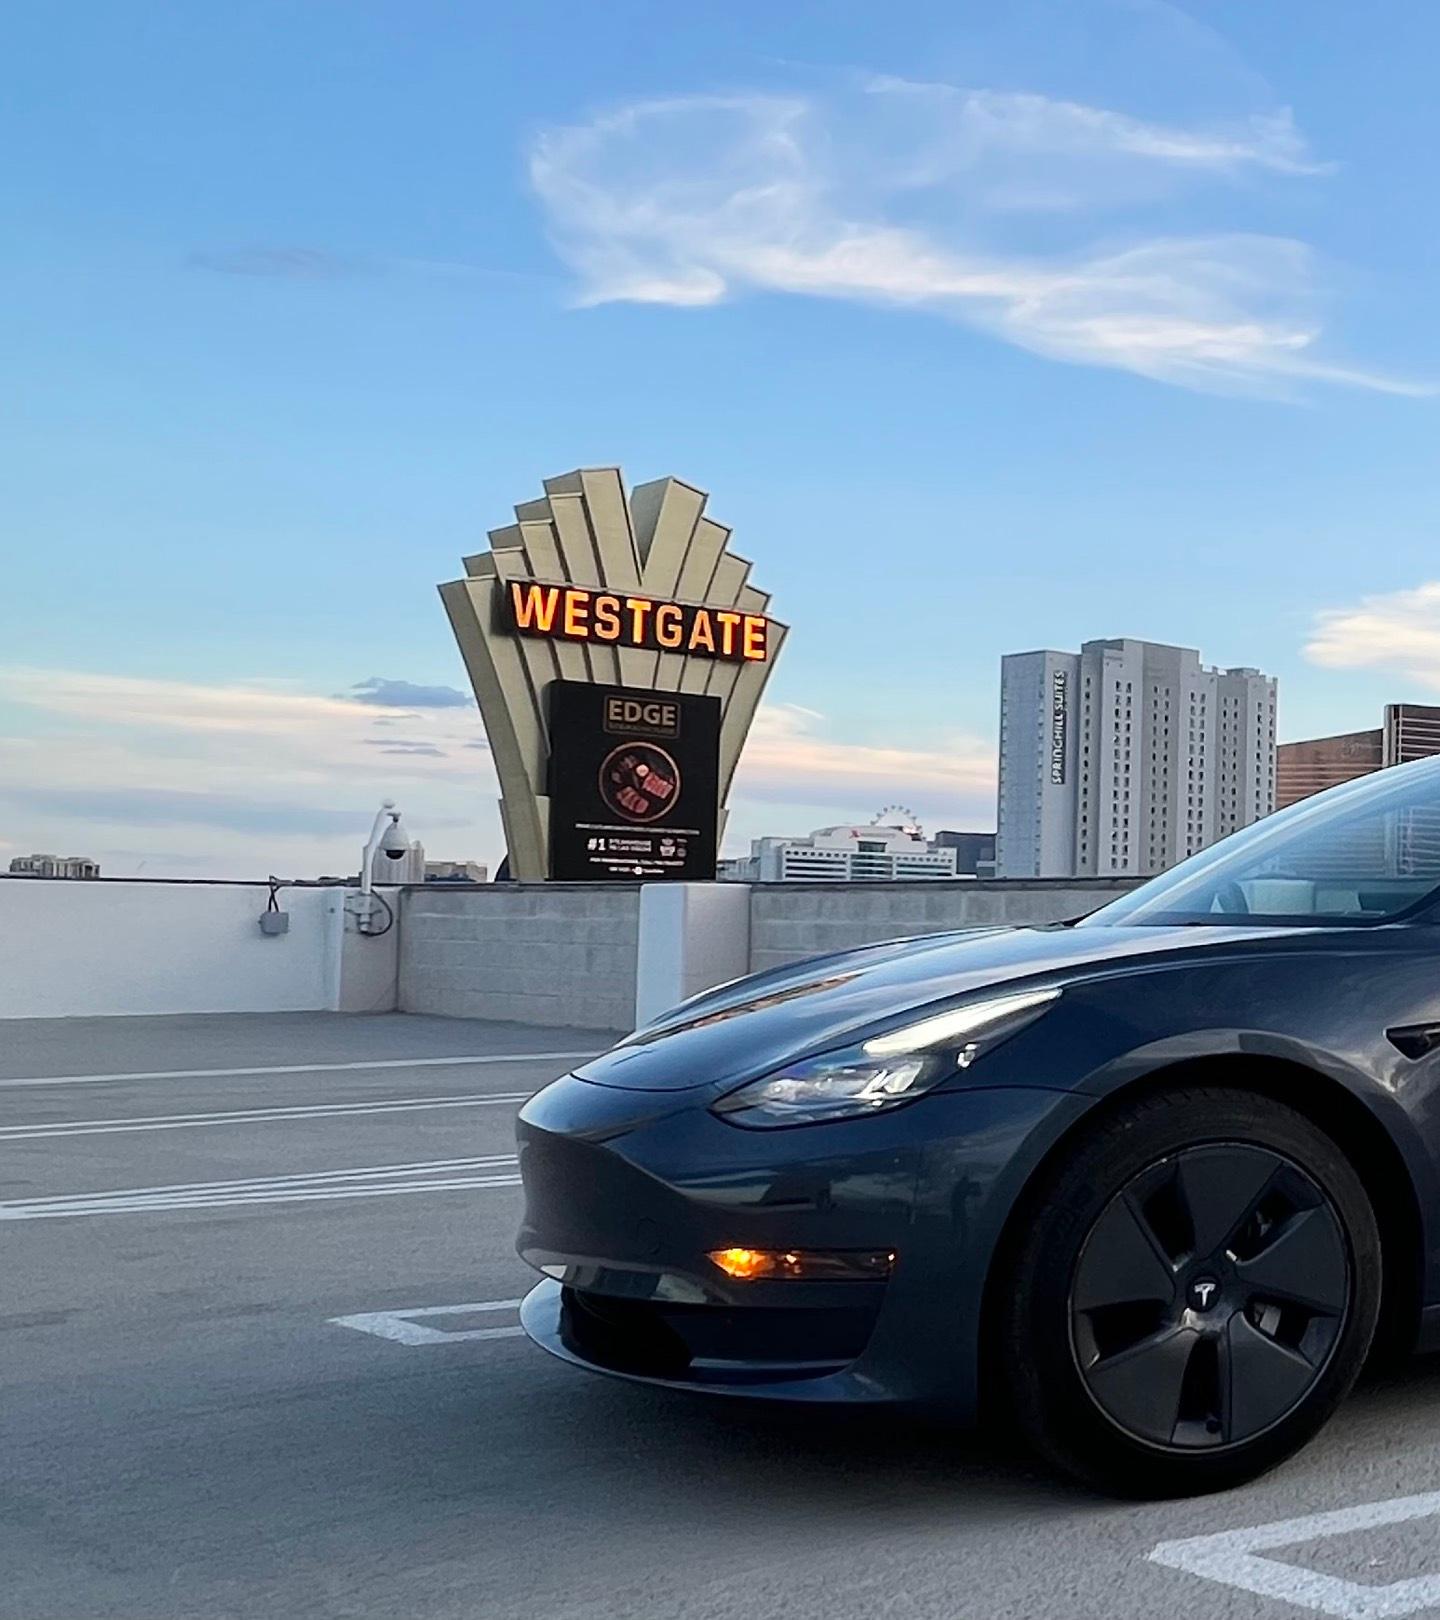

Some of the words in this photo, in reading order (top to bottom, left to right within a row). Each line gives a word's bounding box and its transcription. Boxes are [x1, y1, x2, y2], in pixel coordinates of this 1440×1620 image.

[511, 582, 767, 660] WESTGATE
[1054, 671, 1064, 711] SUITES
[609, 699, 676, 726] EDGE
[1052, 713, 1064, 783] SPRINGHILL
[587, 838, 606, 851] #1
